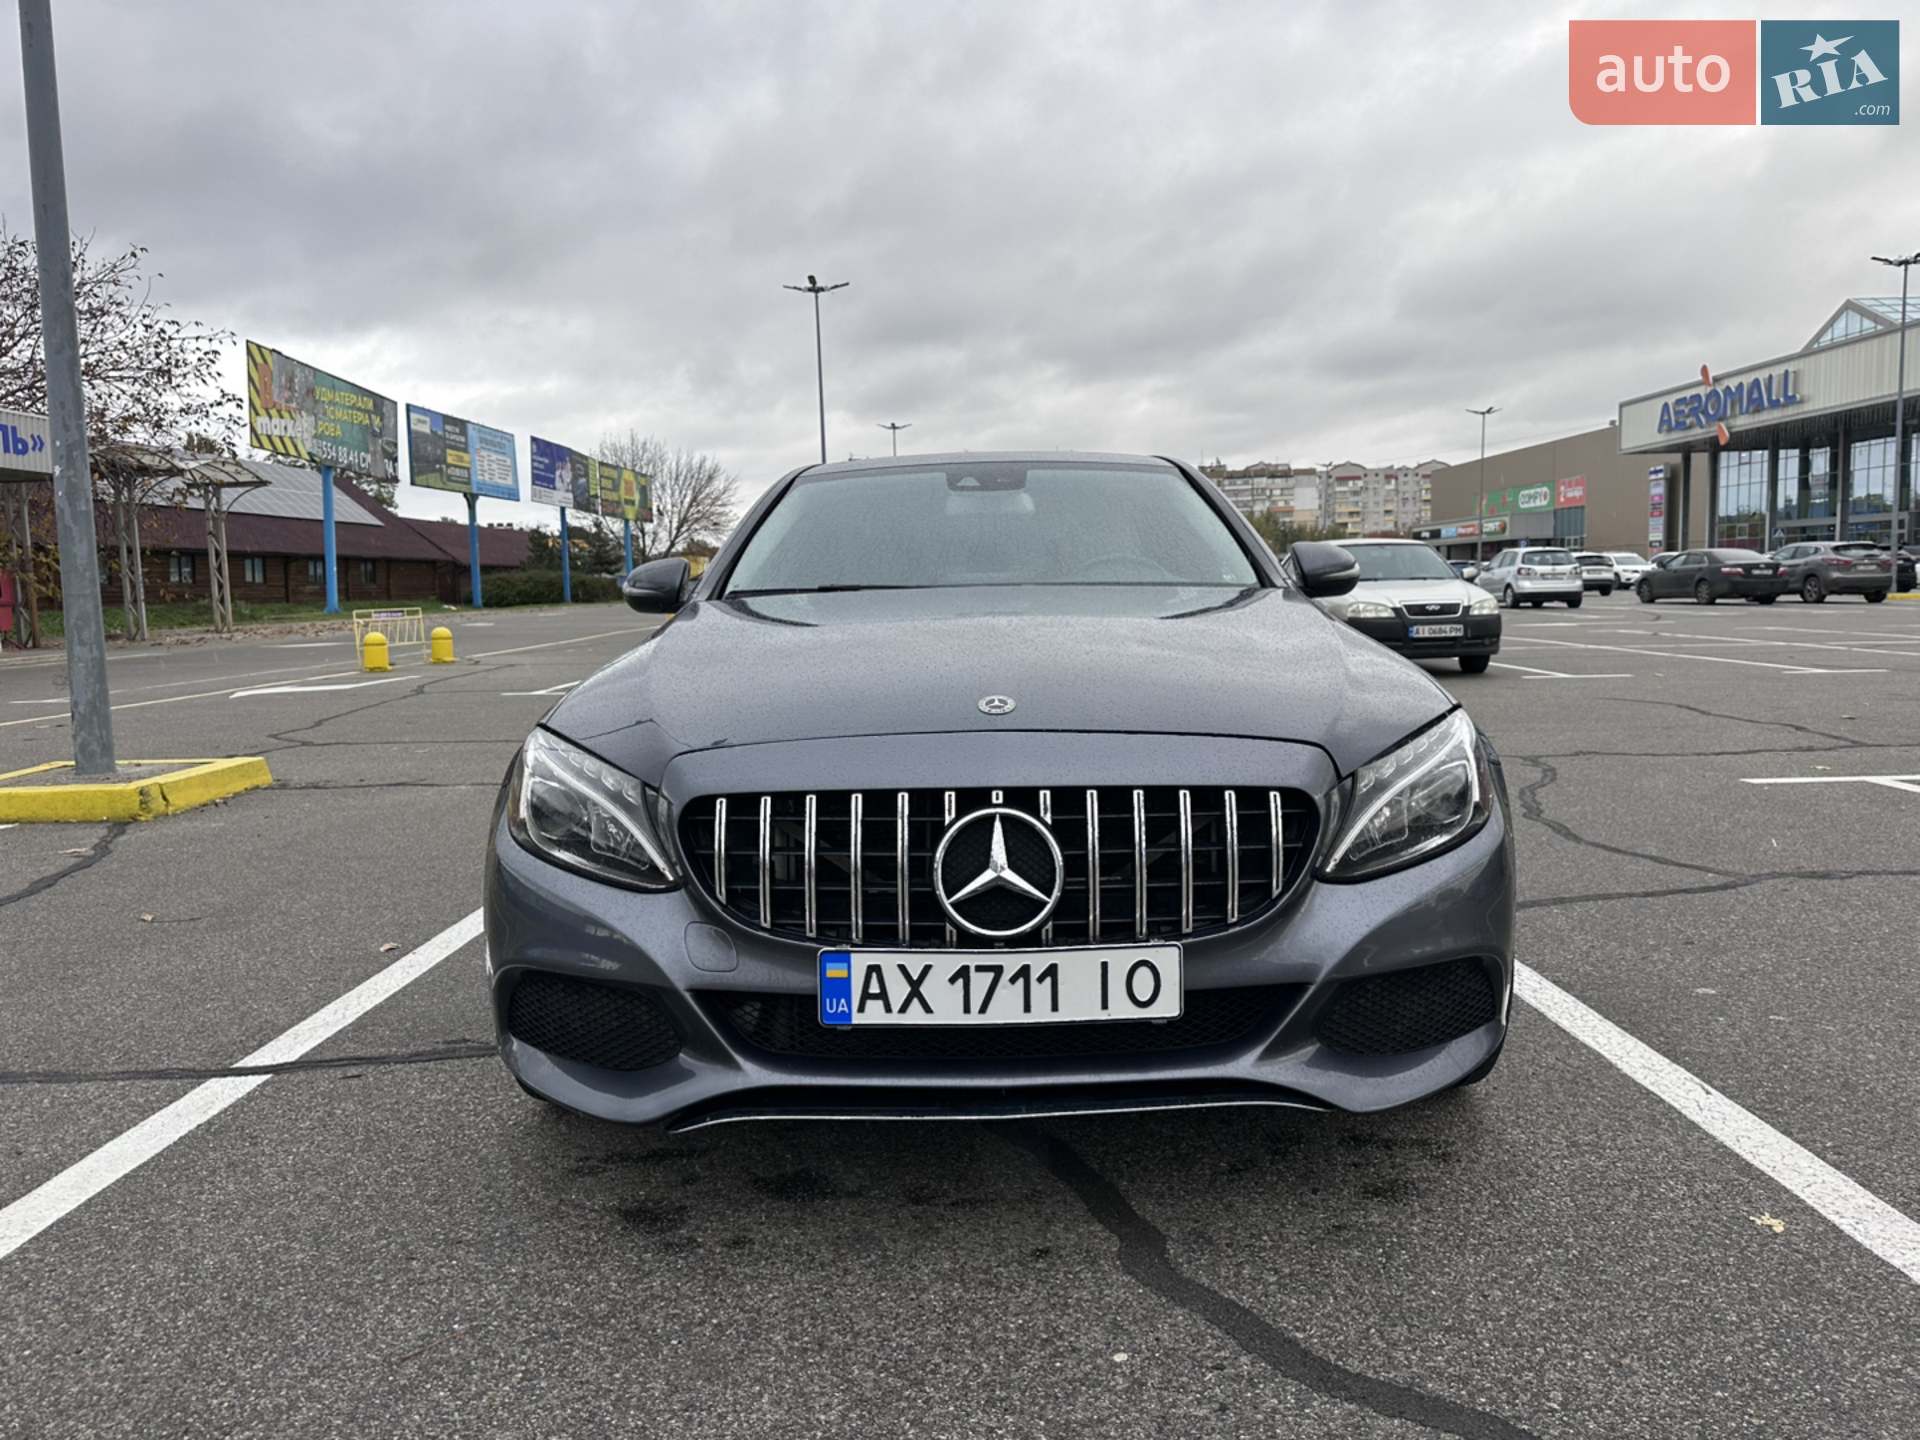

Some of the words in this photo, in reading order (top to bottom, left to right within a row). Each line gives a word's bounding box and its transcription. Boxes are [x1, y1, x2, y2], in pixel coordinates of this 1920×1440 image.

[315, 386, 374, 412] УДМАТЕРІАЛИ
[1657, 368, 1799, 434] AEROMALL
[313, 421, 342, 438] РОВА
[857, 963, 934, 1014] AX
[948, 962, 1059, 1014] 1711
[1100, 959, 1162, 1010] IO
[826, 998, 849, 1013] UA
